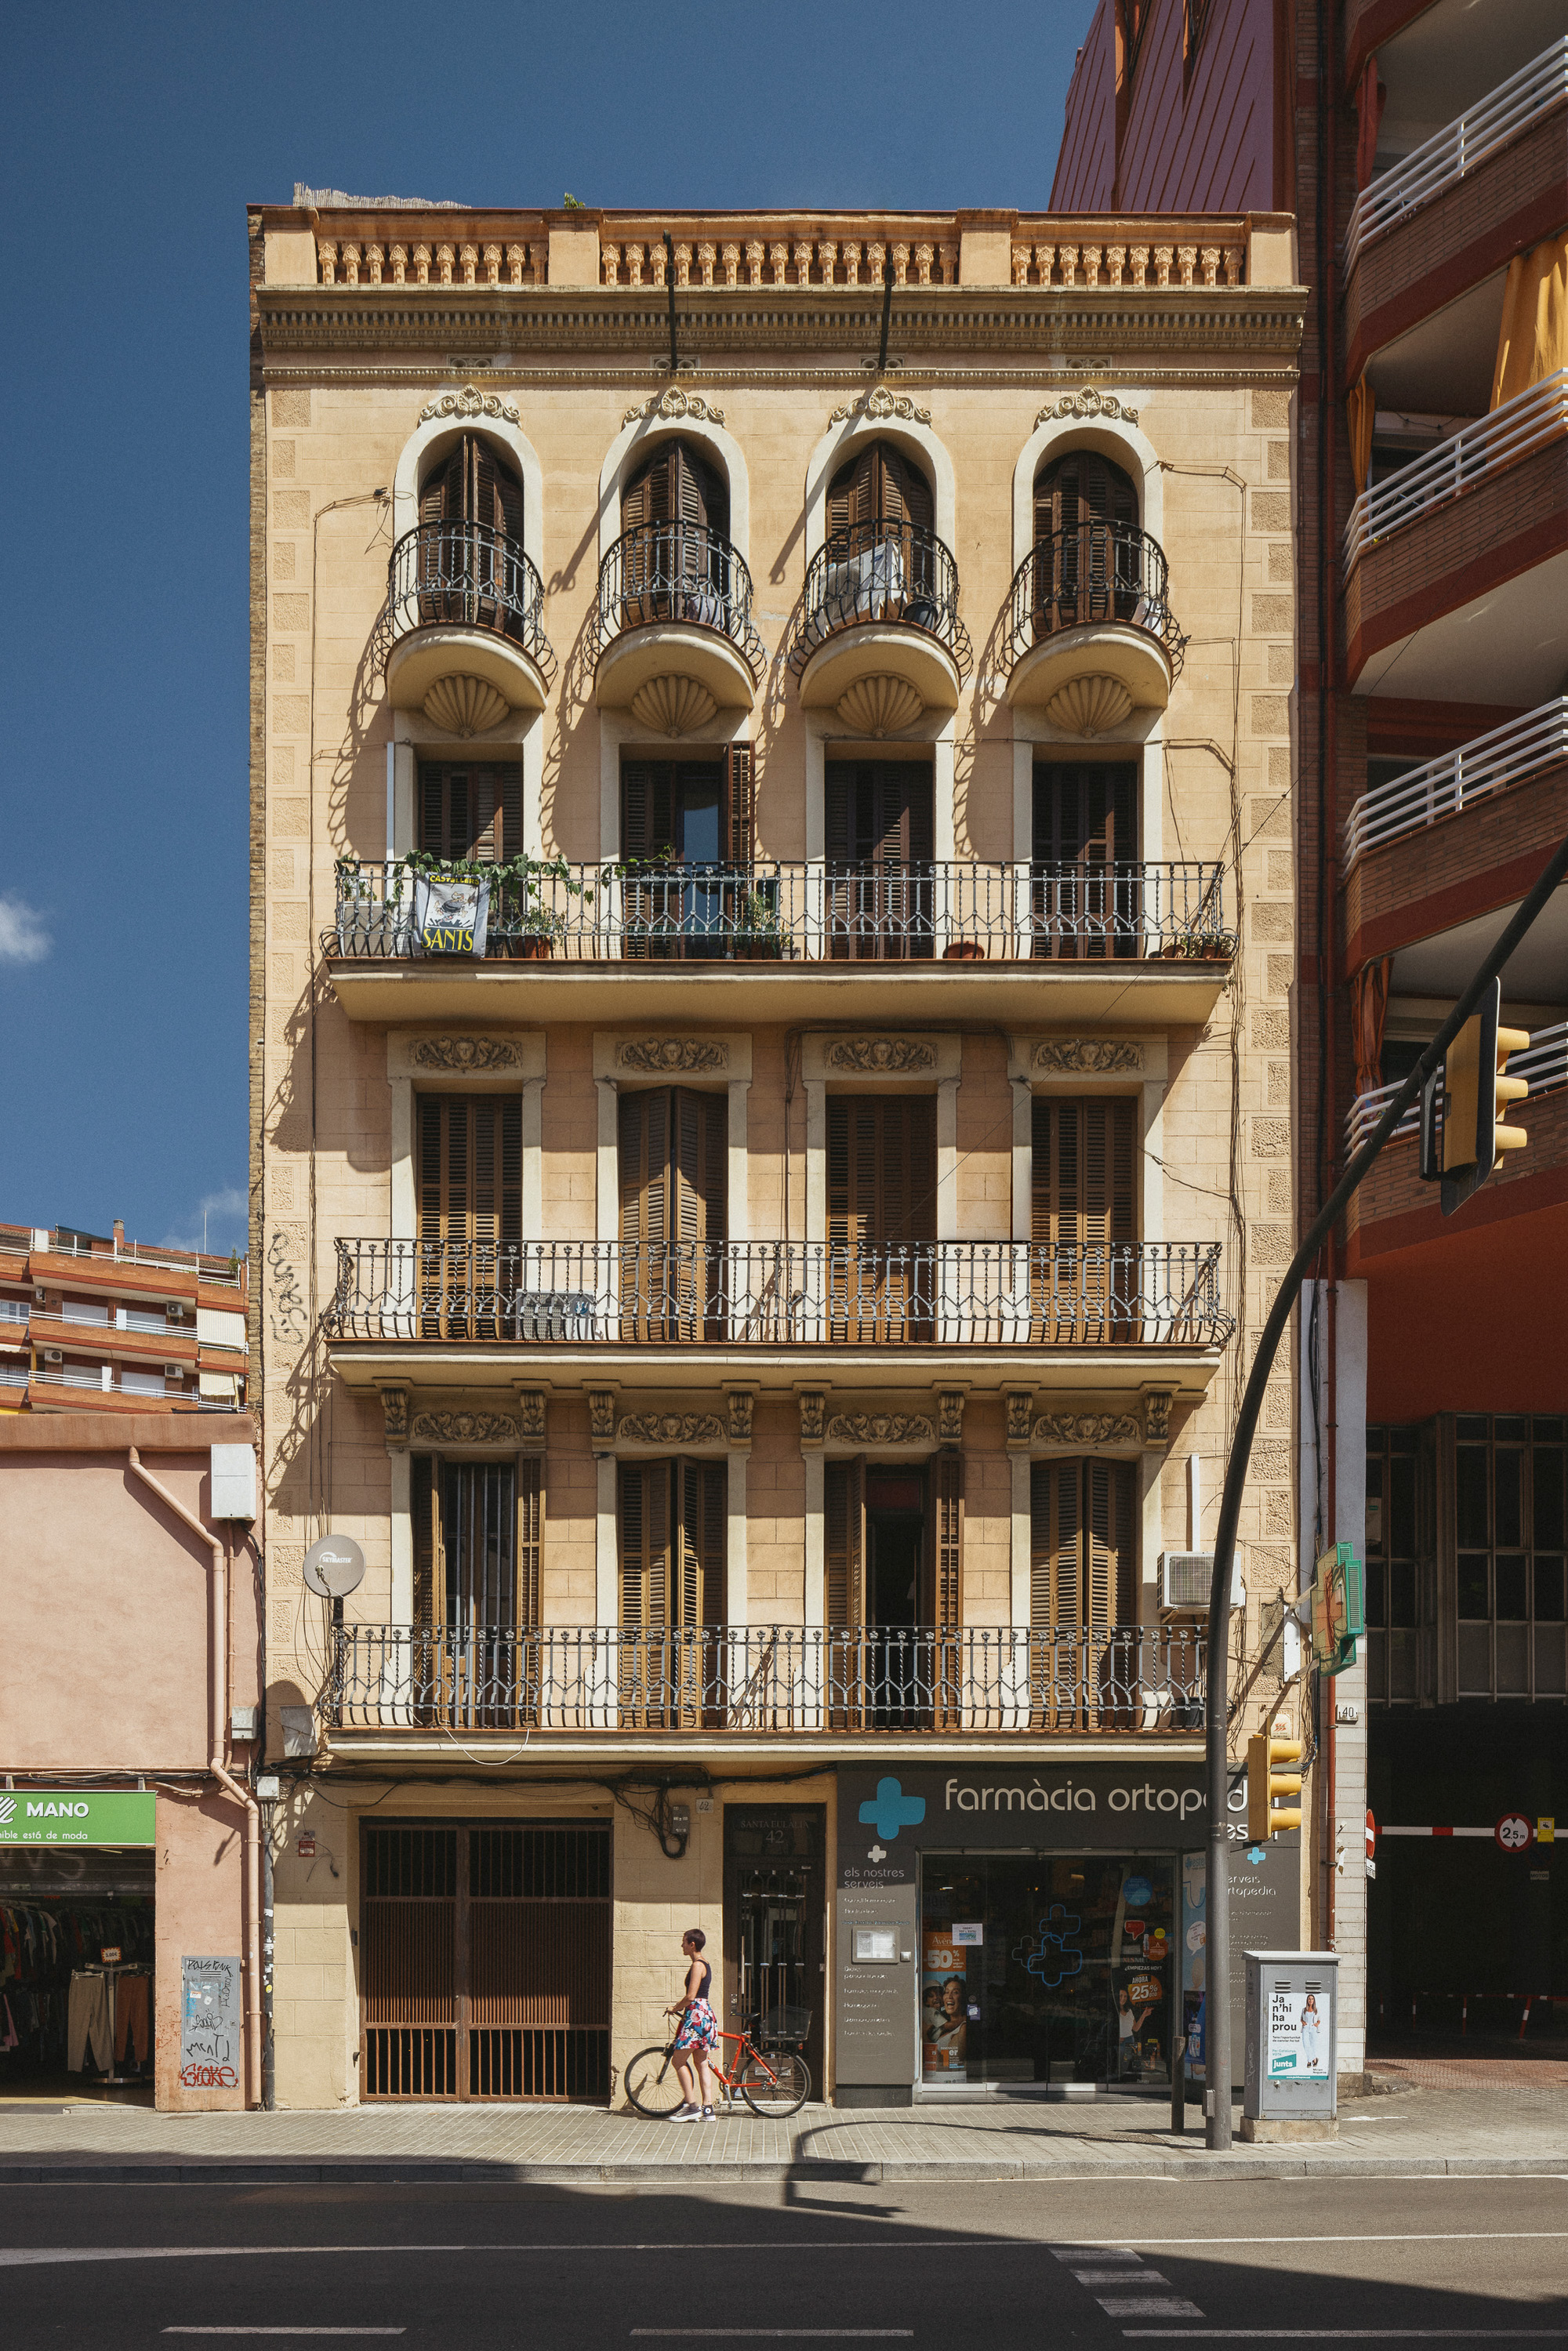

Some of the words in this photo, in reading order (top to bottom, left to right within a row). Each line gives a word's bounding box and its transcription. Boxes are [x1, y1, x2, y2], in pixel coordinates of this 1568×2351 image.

[430, 875, 479, 885] CASTELLERS
[421, 928, 474, 951] SANTS
[1341, 1707, 1354, 1718] 40
[946, 1778, 1096, 1812] farmàcia
[27, 1802, 89, 1818] MANO
[699, 1801, 710, 1811] 42
[771, 1820, 809, 1829] EULALIA
[23, 1831, 42, 1840] está
[46, 1830, 57, 1840] de
[63, 1831, 88, 1840] moda
[765, 1830, 784, 1843] 42
[844, 1867, 860, 1878] els
[863, 1869, 905, 1878] nostres
[844, 1879, 884, 1888] serveis
[1272, 1994, 1284, 2004] Ja
[1272, 2012, 1284, 2021] ha
[1272, 2023, 1297, 2033] prou
[1273, 2059, 1294, 2069] junts
